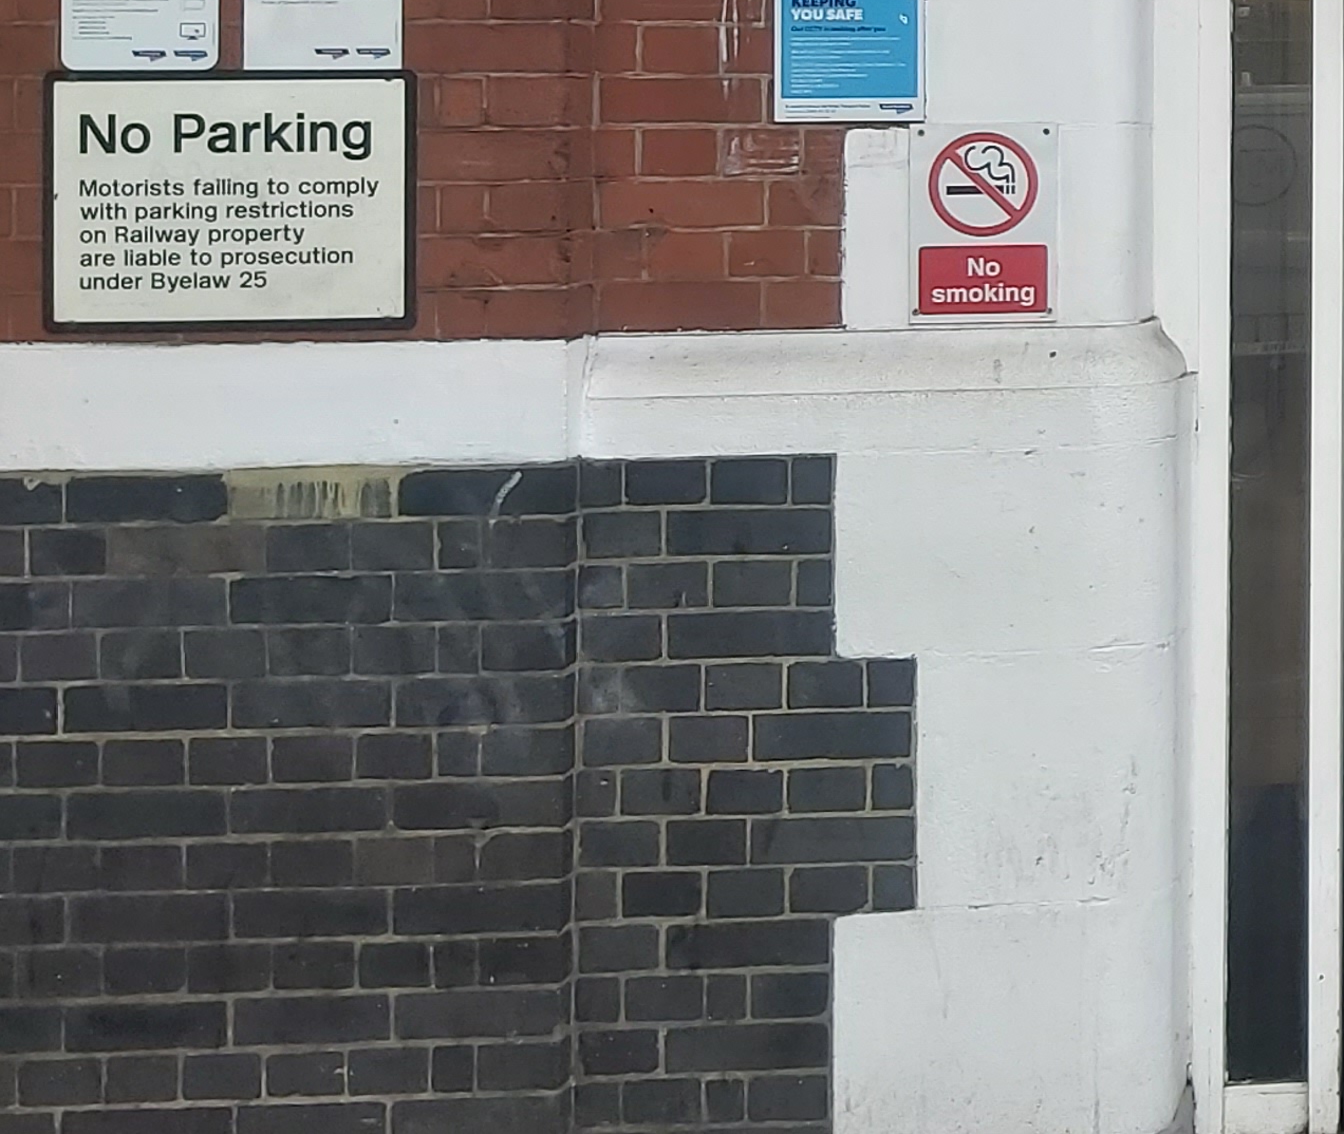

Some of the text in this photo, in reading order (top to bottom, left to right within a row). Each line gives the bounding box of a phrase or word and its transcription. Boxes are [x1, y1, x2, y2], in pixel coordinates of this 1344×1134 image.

[791, 9, 863, 20] YOU SAFE
[79, 112, 372, 161] No Parking
[79, 177, 379, 199] Motorists failing to comply
[80, 201, 354, 223] with parking restrictions
[80, 225, 305, 246] on Railway property
[80, 247, 354, 269] are liable to prosecution
[967, 258, 1001, 277] No
[80, 271, 268, 294] under Byelaw 25
[931, 283, 1035, 306] smoking
